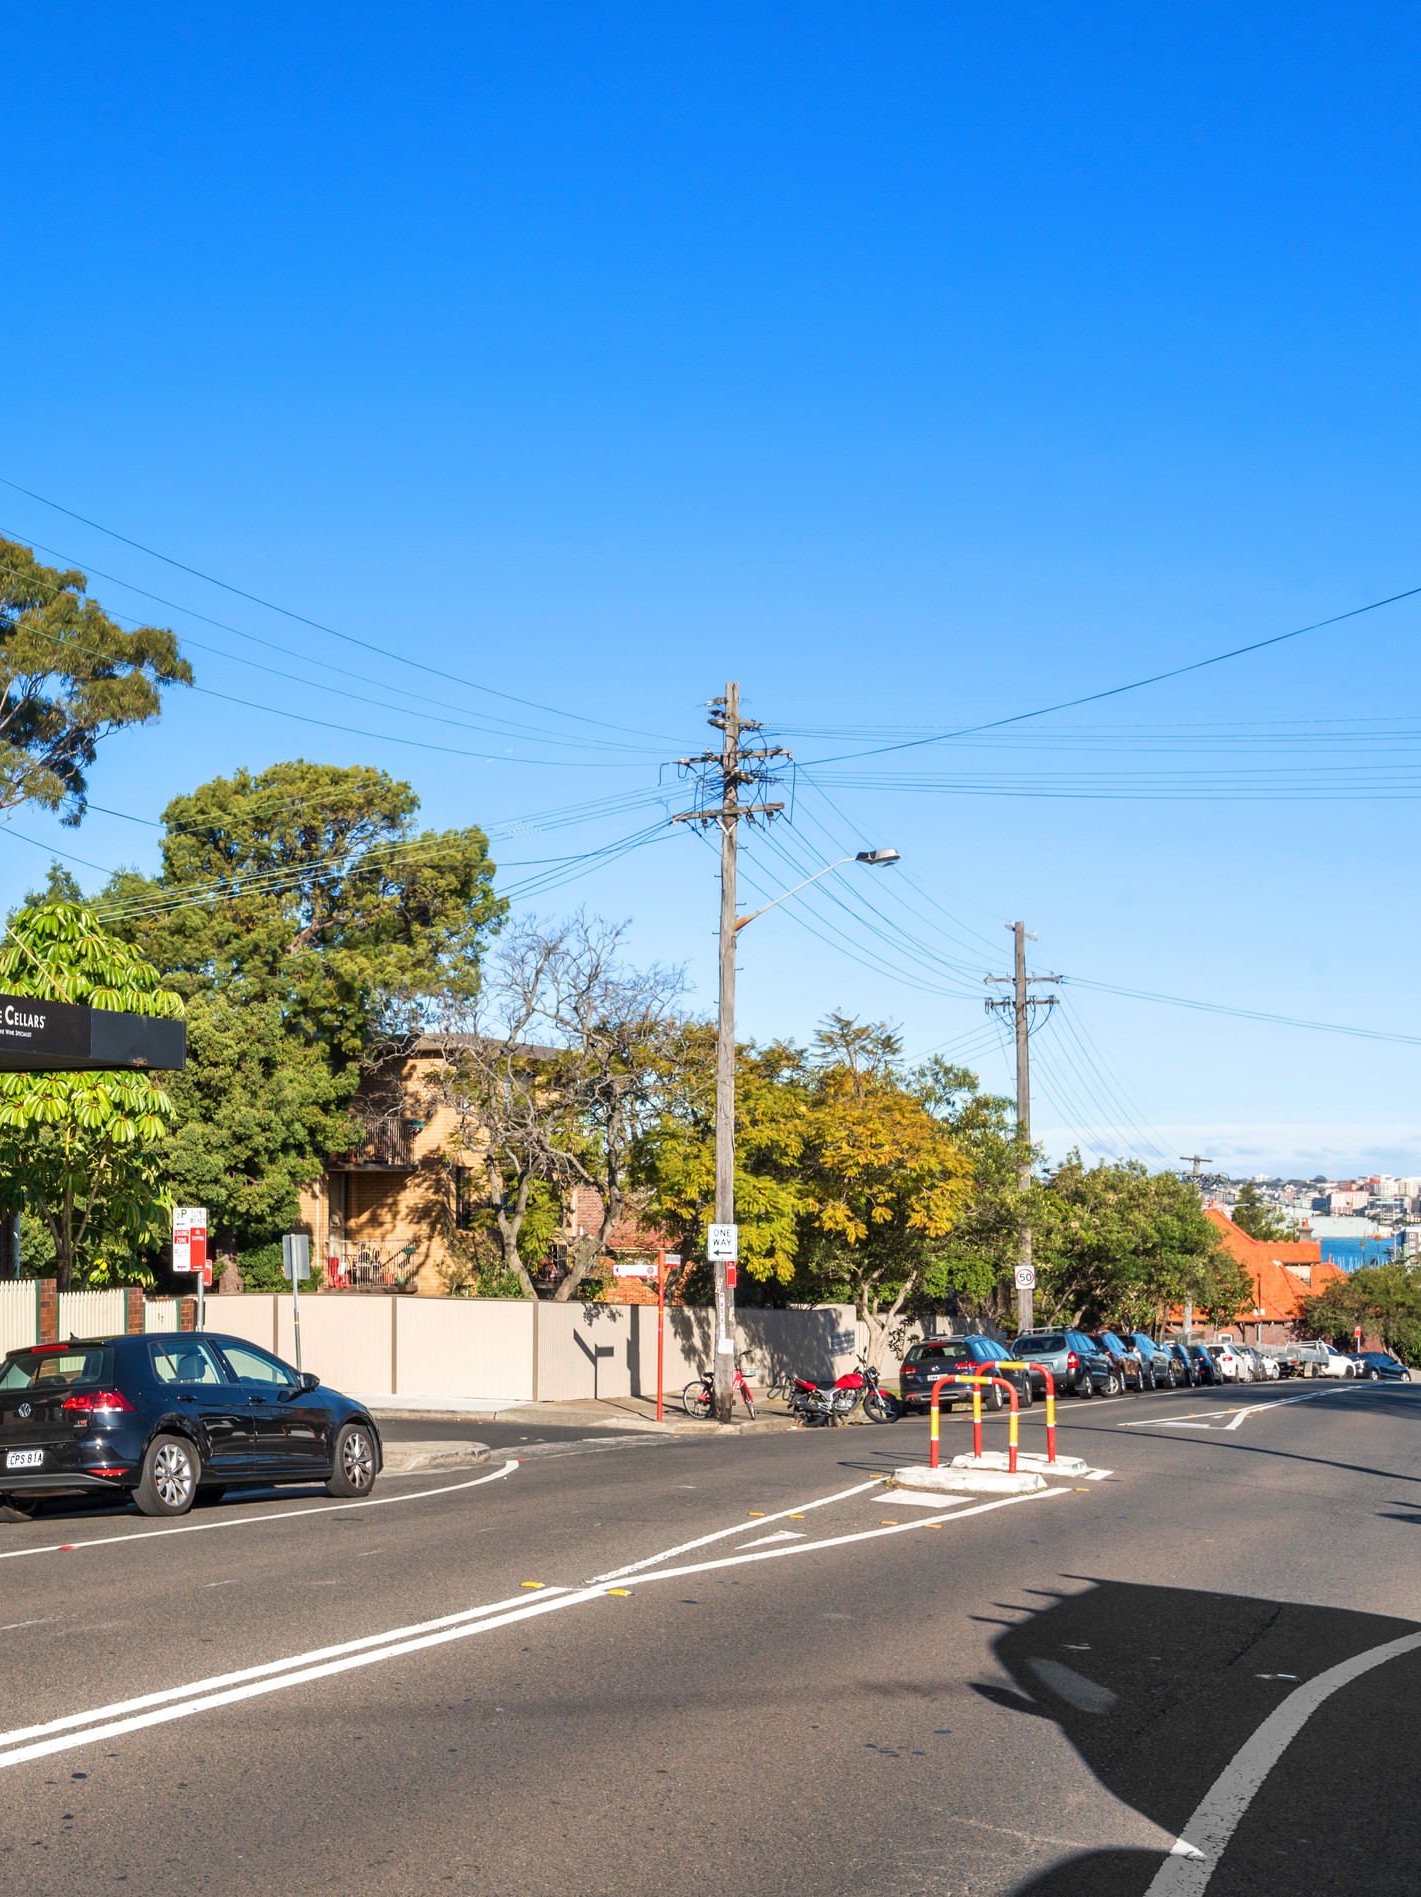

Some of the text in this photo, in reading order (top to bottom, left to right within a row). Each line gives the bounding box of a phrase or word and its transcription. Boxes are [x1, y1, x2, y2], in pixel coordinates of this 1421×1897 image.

[5, 1005, 45, 1029] CELLARS
[713, 1229, 731, 1237] ONE
[1019, 1273, 1032, 1282] 50
